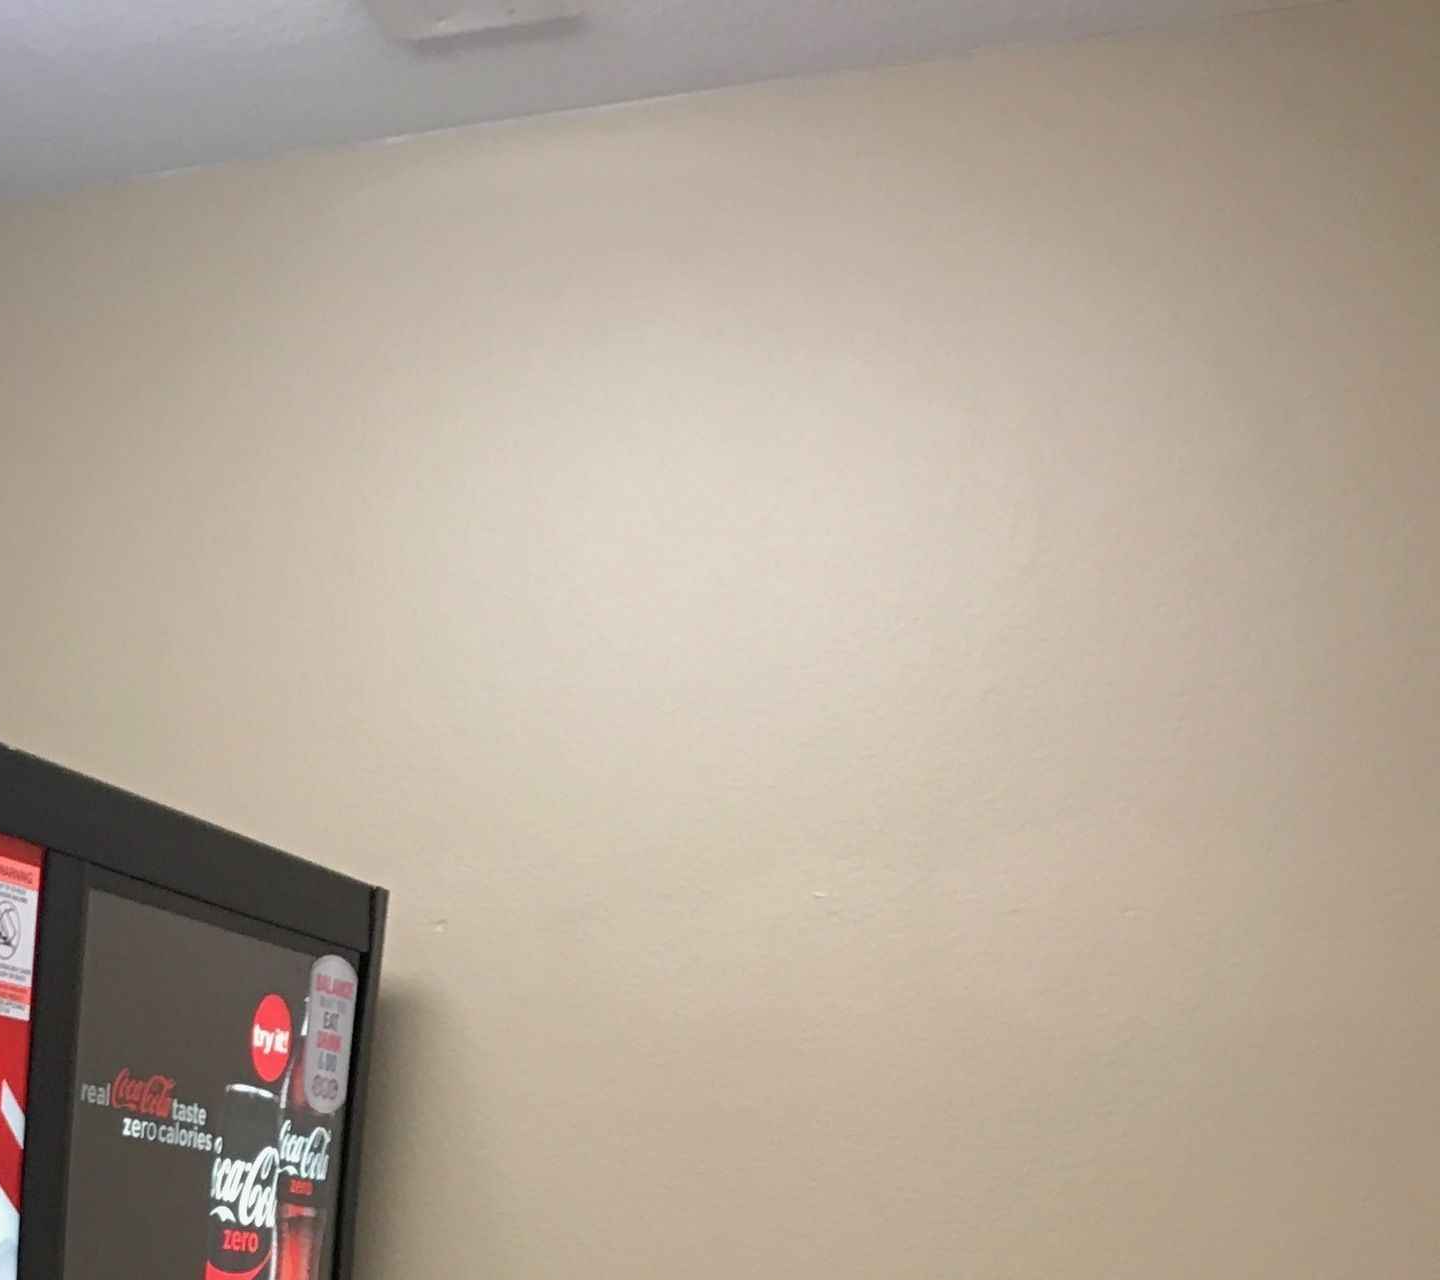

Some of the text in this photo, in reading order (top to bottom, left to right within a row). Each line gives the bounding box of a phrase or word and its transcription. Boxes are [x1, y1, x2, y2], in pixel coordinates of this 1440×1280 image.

[252, 1025, 274, 1055] try
[81, 1067, 208, 1126] real Coca-Cola taste
[122, 1116, 212, 1152] zero calories
[289, 1178, 313, 1197] zero
[223, 1229, 259, 1253] zero
